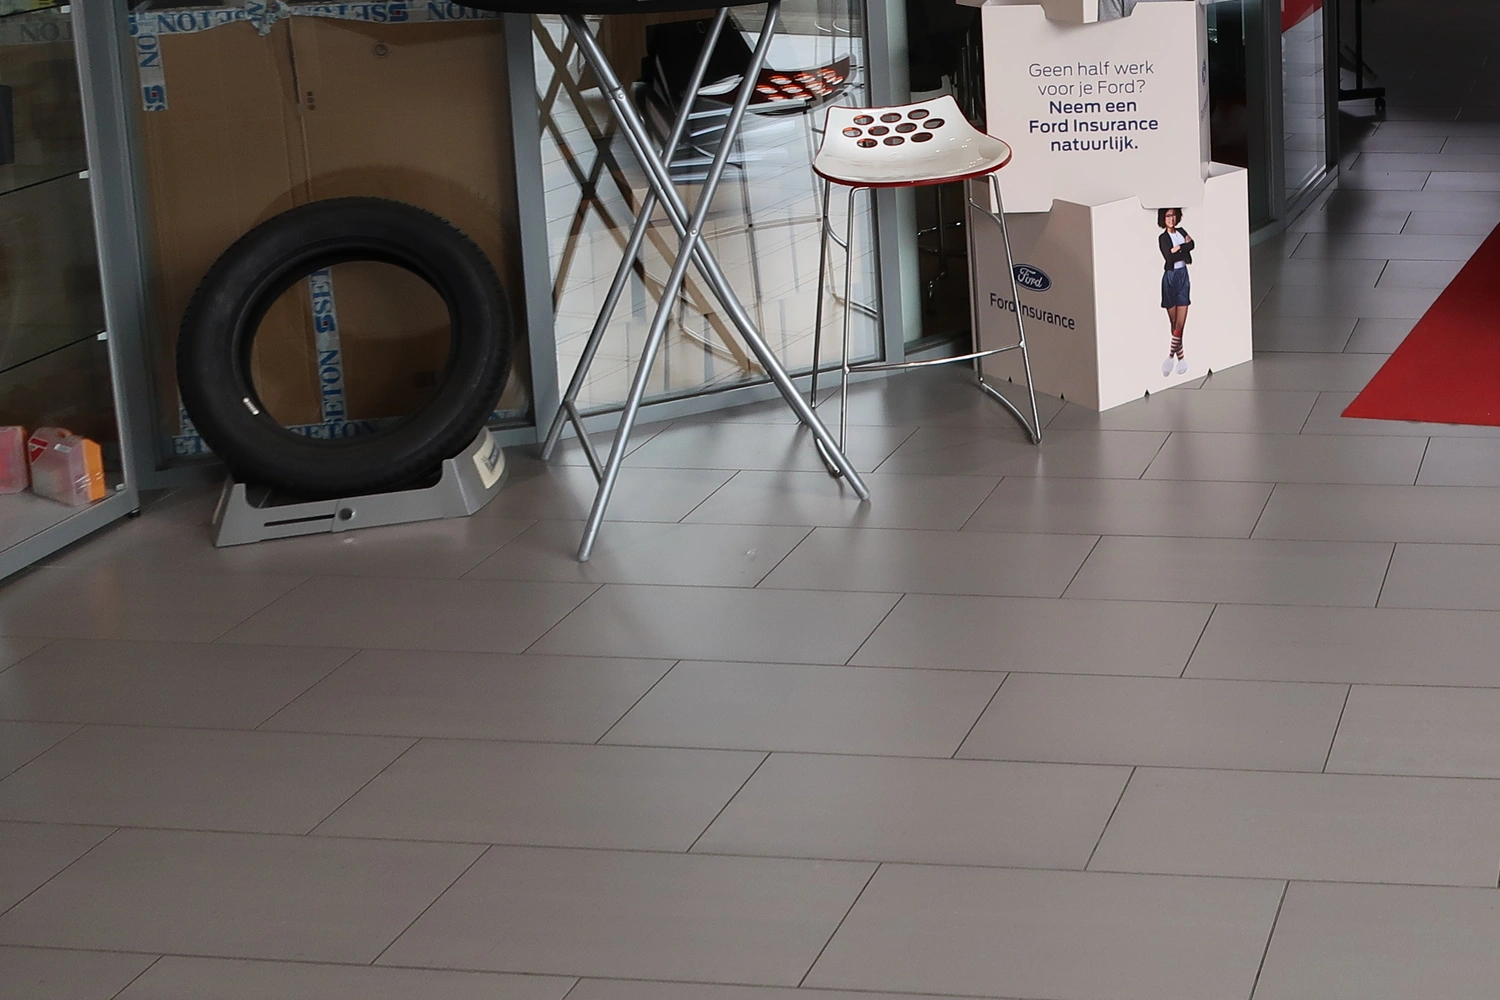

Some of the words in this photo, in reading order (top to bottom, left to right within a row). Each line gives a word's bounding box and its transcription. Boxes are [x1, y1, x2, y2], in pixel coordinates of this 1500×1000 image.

[1028, 62, 1073, 78] Geen
[1077, 61, 1110, 77] half
[1113, 60, 1155, 76] werk
[1037, 83, 1075, 96] voor
[1079, 80, 1093, 97] je
[1098, 79, 1146, 95] Ford?
[1049, 99, 1101, 114] Neem
[1105, 99, 1137, 113] een
[1029, 119, 1069, 133] Ford
[1073, 117, 1159, 132] Insurance
[1050, 136, 1139, 152] natuurlijk.
[1017, 267, 1044, 290] Ford
[989, 292, 1017, 313] Ford
[1018, 300, 1076, 331] Insurance
